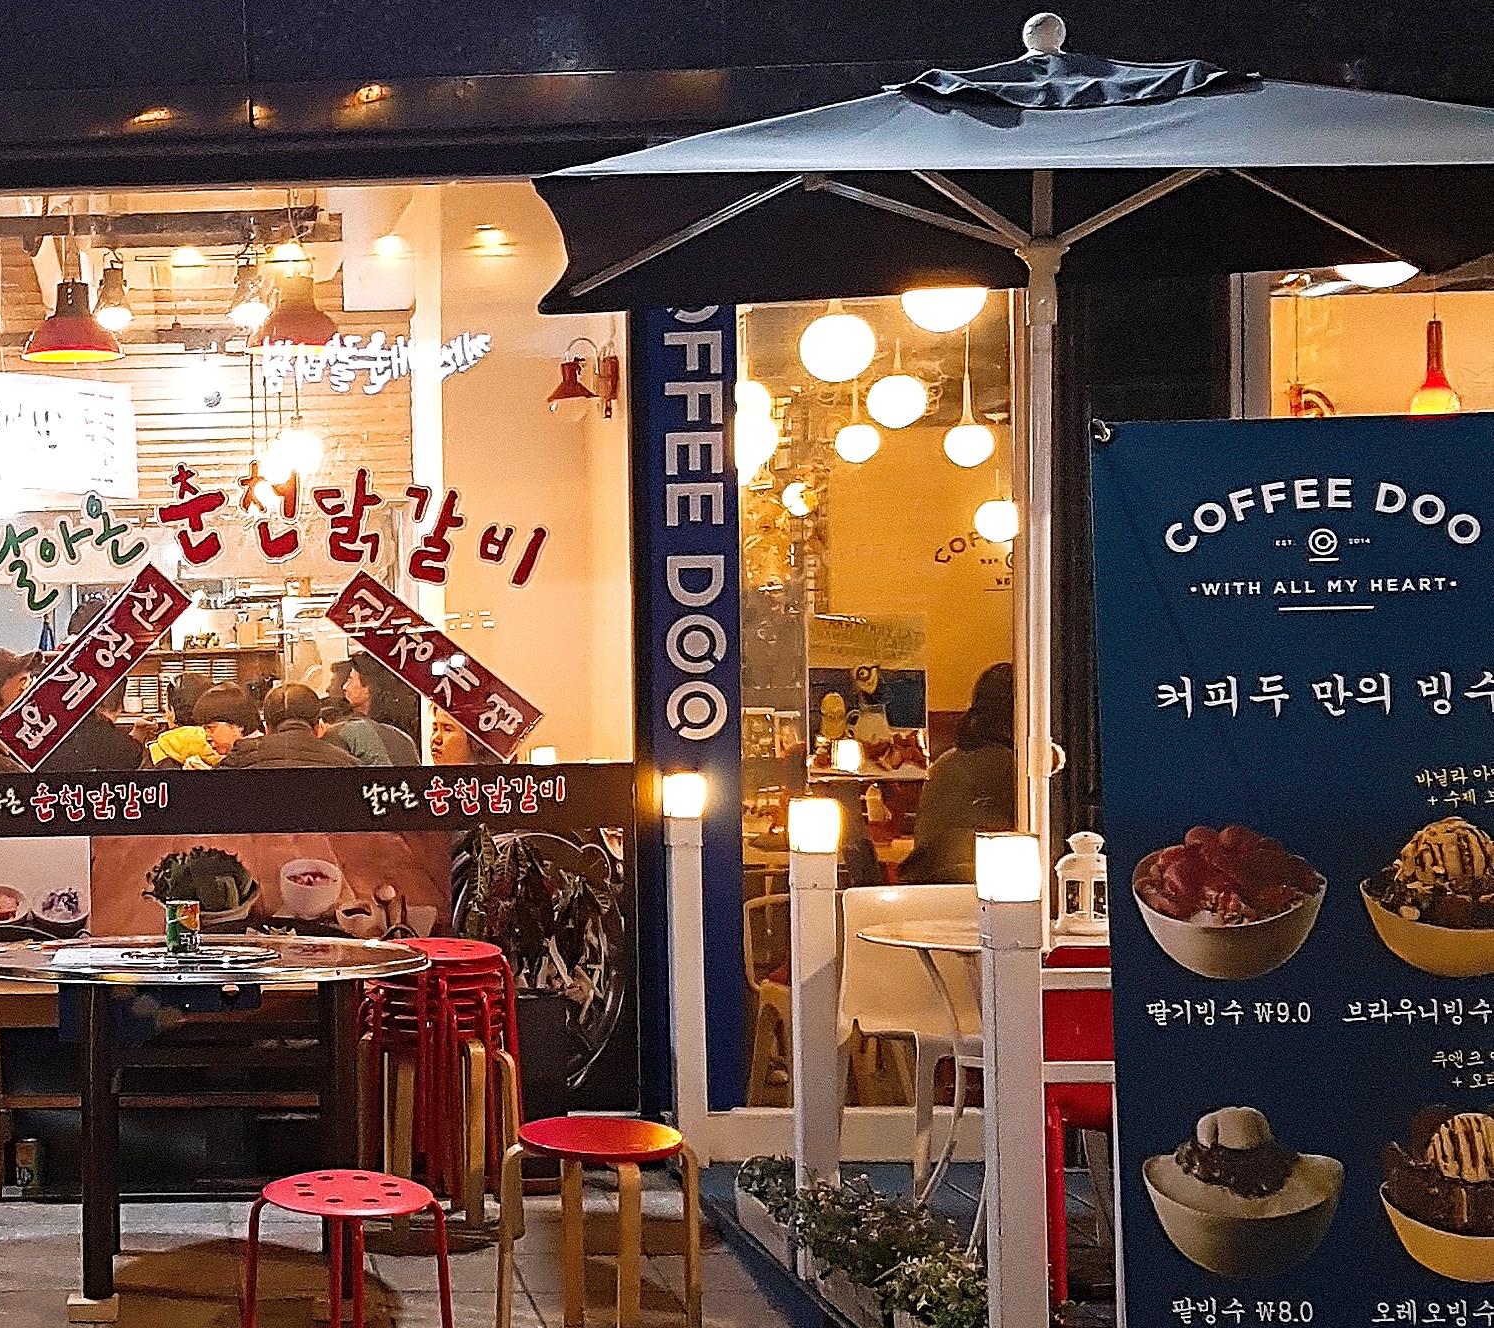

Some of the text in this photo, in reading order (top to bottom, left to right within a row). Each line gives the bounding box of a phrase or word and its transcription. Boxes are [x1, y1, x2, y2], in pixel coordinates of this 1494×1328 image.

[154, 460, 551, 590] 춘천닭갈비
[1164, 478, 1482, 554] COFFEE DOO
[1201, 576, 1446, 597] WITH ALL MY HEART
[13, 583, 174, 751] 신장개업
[346, 587, 525, 736] 신장개업
[665, 554, 729, 742] DOO
[1156, 675, 1290, 719] 커피두
[1311, 672, 1392, 718] 만의
[362, 775, 567, 817] 날아온 춘천닭갈비
[1414, 764, 1494, 789] 바닐라 아
[30, 781, 169, 823] 춘천닭갈비
[1443, 788, 1477, 809] 수제
[1146, 998, 1245, 1027] 딸기빙수
[1341, 998, 1493, 1026] 브라우니빙수
[1171, 1296, 1246, 1325] 팥빙수
